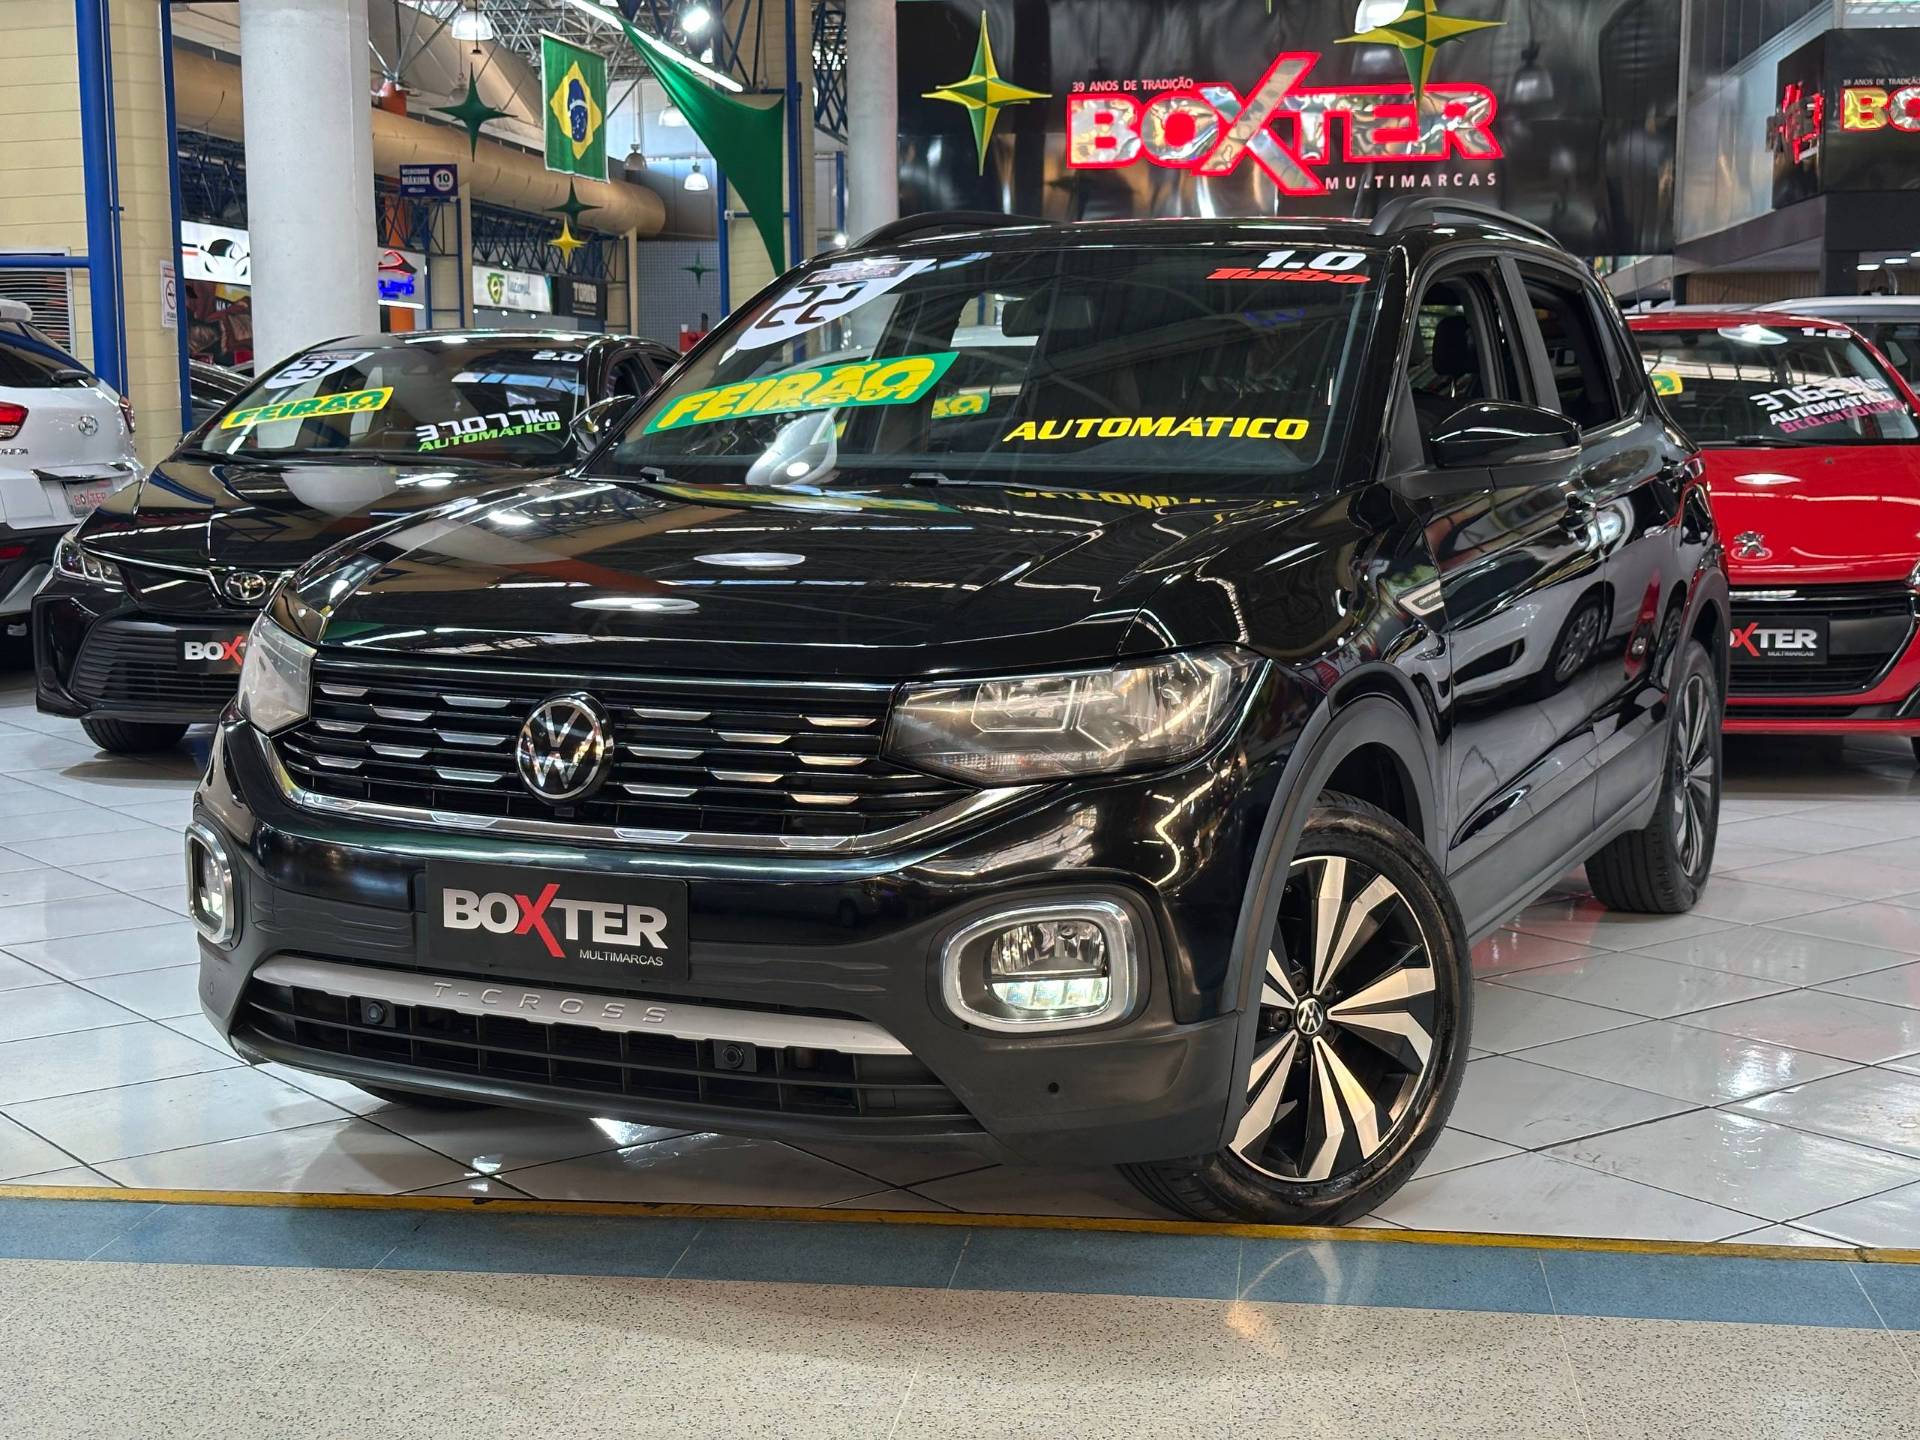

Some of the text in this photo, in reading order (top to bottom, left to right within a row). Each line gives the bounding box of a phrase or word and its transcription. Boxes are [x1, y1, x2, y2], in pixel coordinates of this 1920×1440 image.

[1072, 76, 1193, 92] 39 ANOS DE TRADIÇÃO
[1067, 52, 1504, 195] BOXTER
[437, 173, 450, 183] 10
[1325, 172, 1496, 190] MULTIMARCAS
[1257, 250, 1367, 271] 1.0
[755, 281, 868, 329] 22
[532, 350, 584, 362] 2.0
[275, 361, 337, 379] 23
[1730, 622, 1818, 657] XTER
[442, 883, 668, 958] BOXTER
[579, 949, 664, 967] MULTIMARCAS
[433, 982, 668, 1023] T-CROSS
